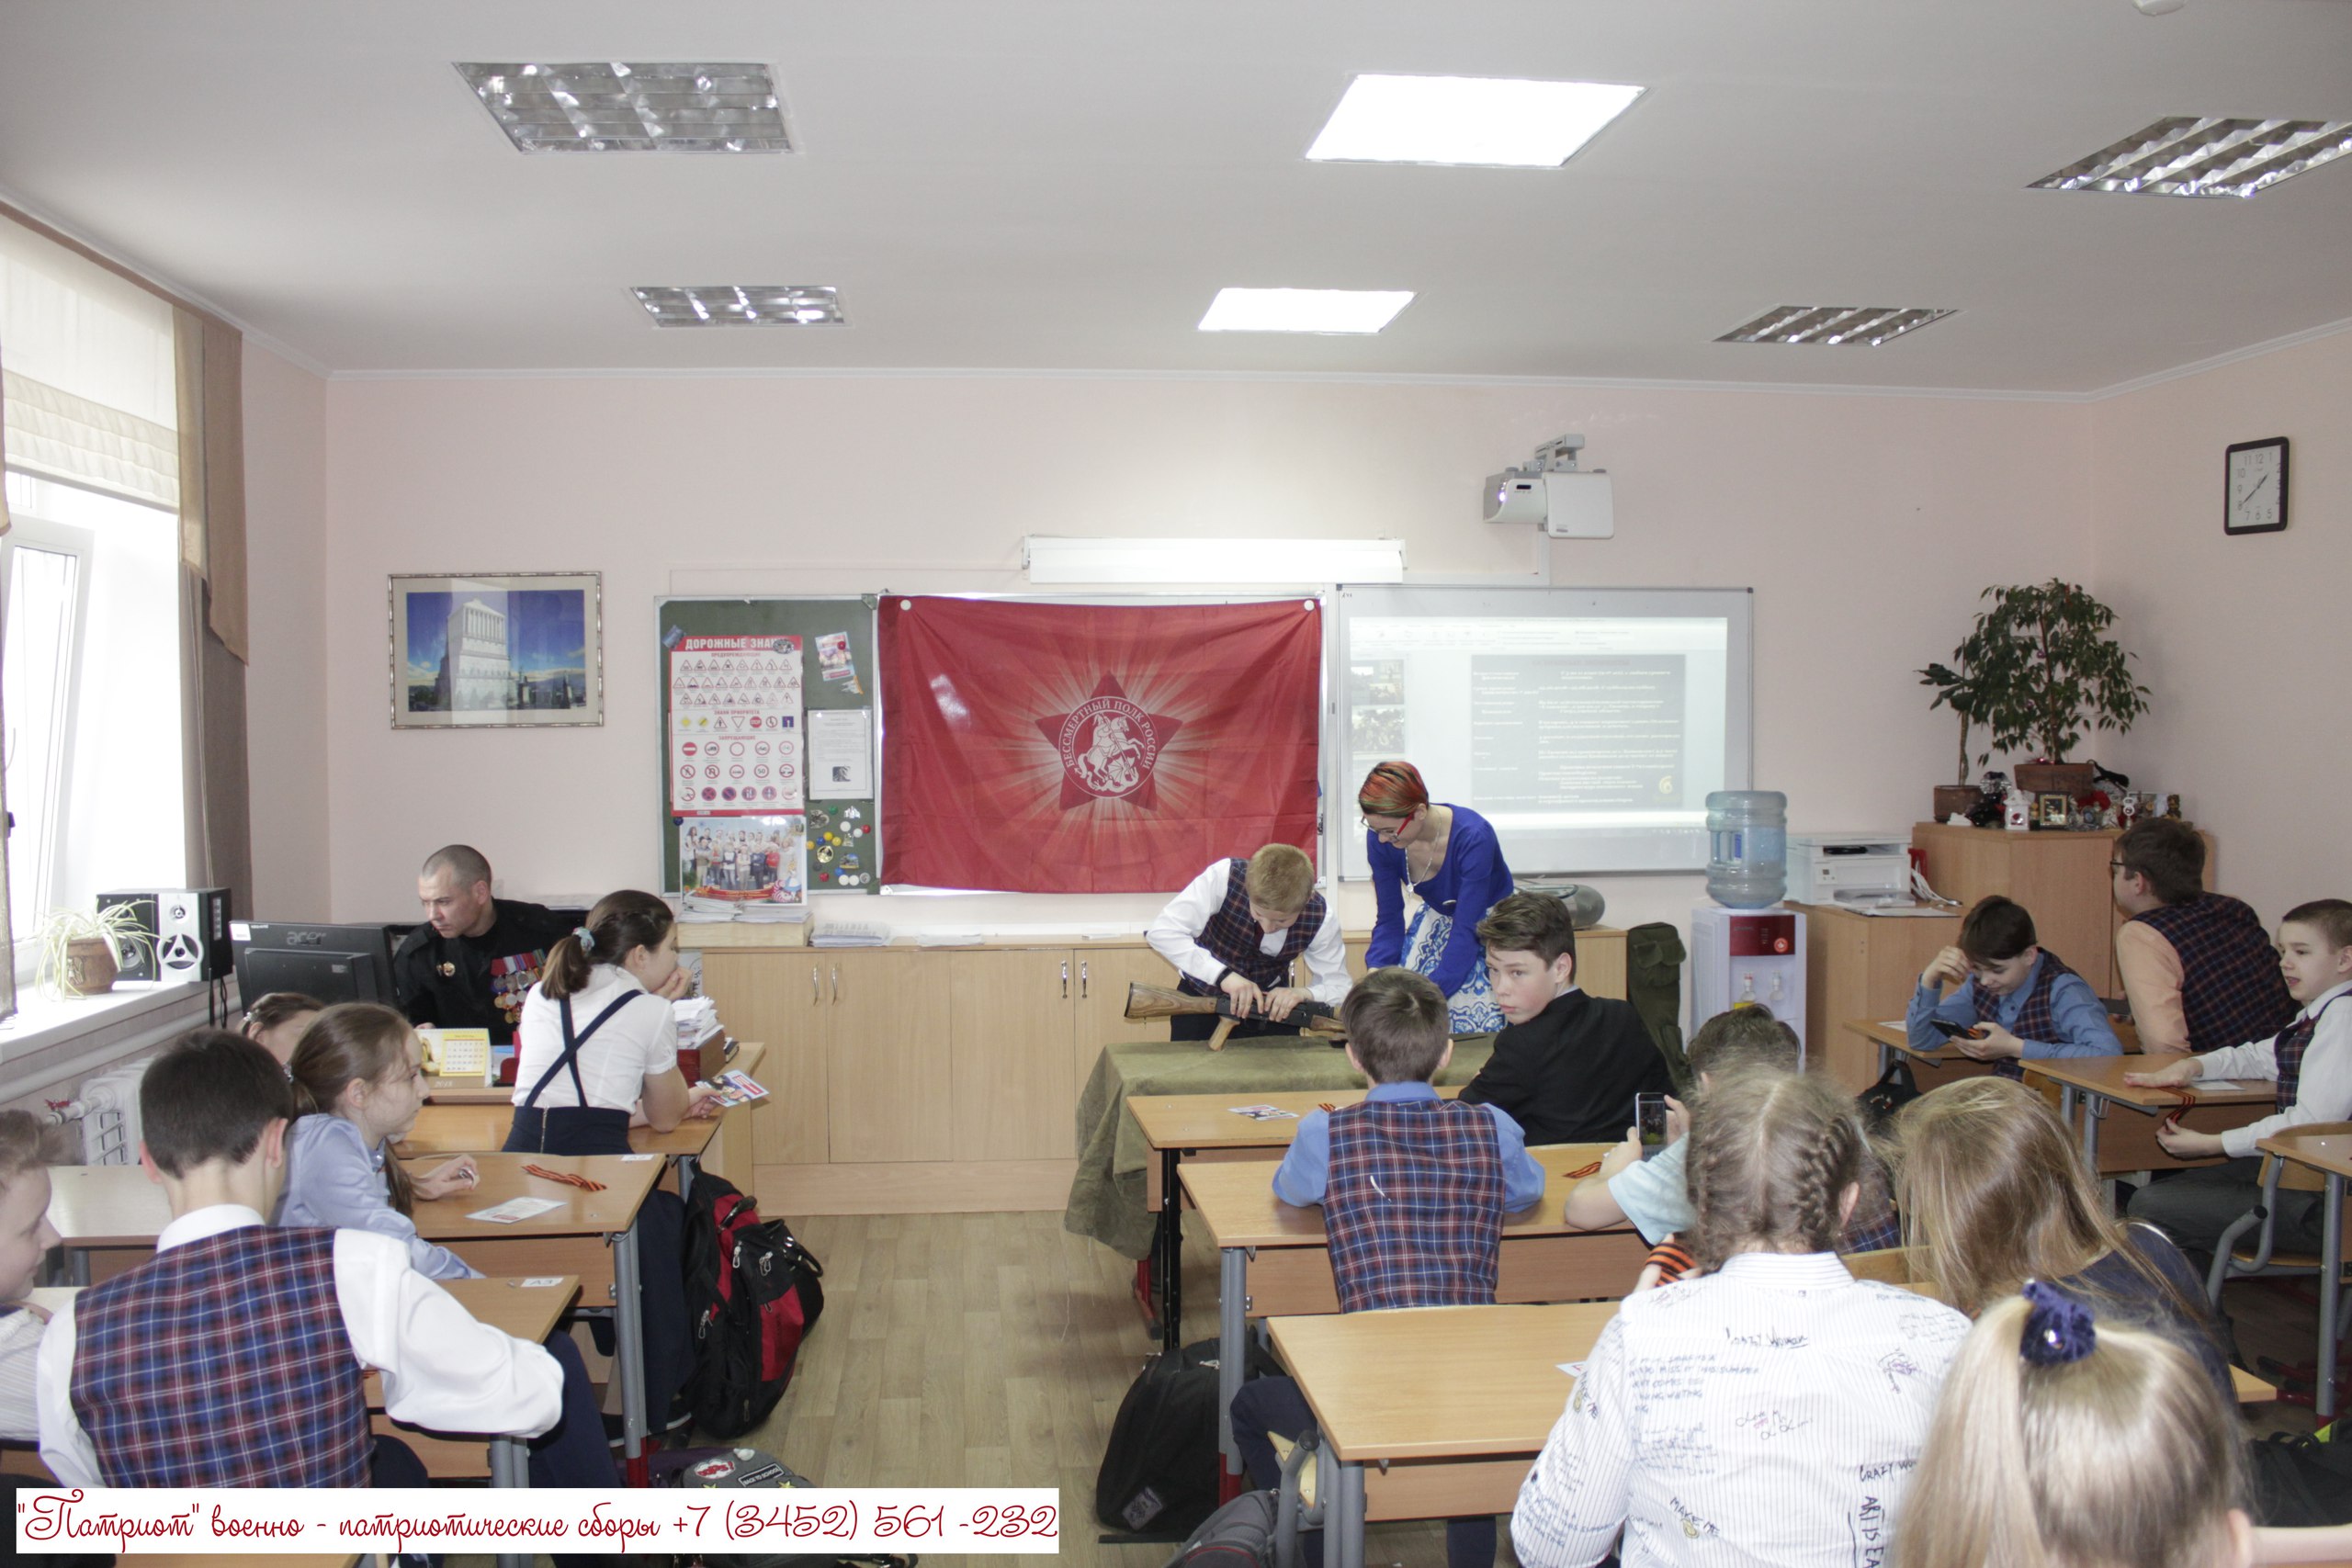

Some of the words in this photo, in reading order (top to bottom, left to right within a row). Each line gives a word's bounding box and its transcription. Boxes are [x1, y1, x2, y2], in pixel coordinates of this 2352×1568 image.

[2244, 456, 2252, 466] 11
[2256, 454, 2264, 465] 12
[684, 638, 746, 650] ДОРОЖНЫЕ
[750, 637, 776, 649] ЗНА
[1062, 698, 1111, 768] БЕССМЕРТНЫЙ
[1114, 700, 1146, 723] ПОЛК
[1141, 722, 1157, 770] РОССИИ
[286, 931, 326, 946] acer
[1860, 1462, 1894, 1483] CRAZY
[1859, 1495, 1885, 1523] ART
[1669, 1496, 1703, 1528] MAKE
[1703, 1521, 1720, 1538] ME
[1861, 1528, 1881, 1541] IS
